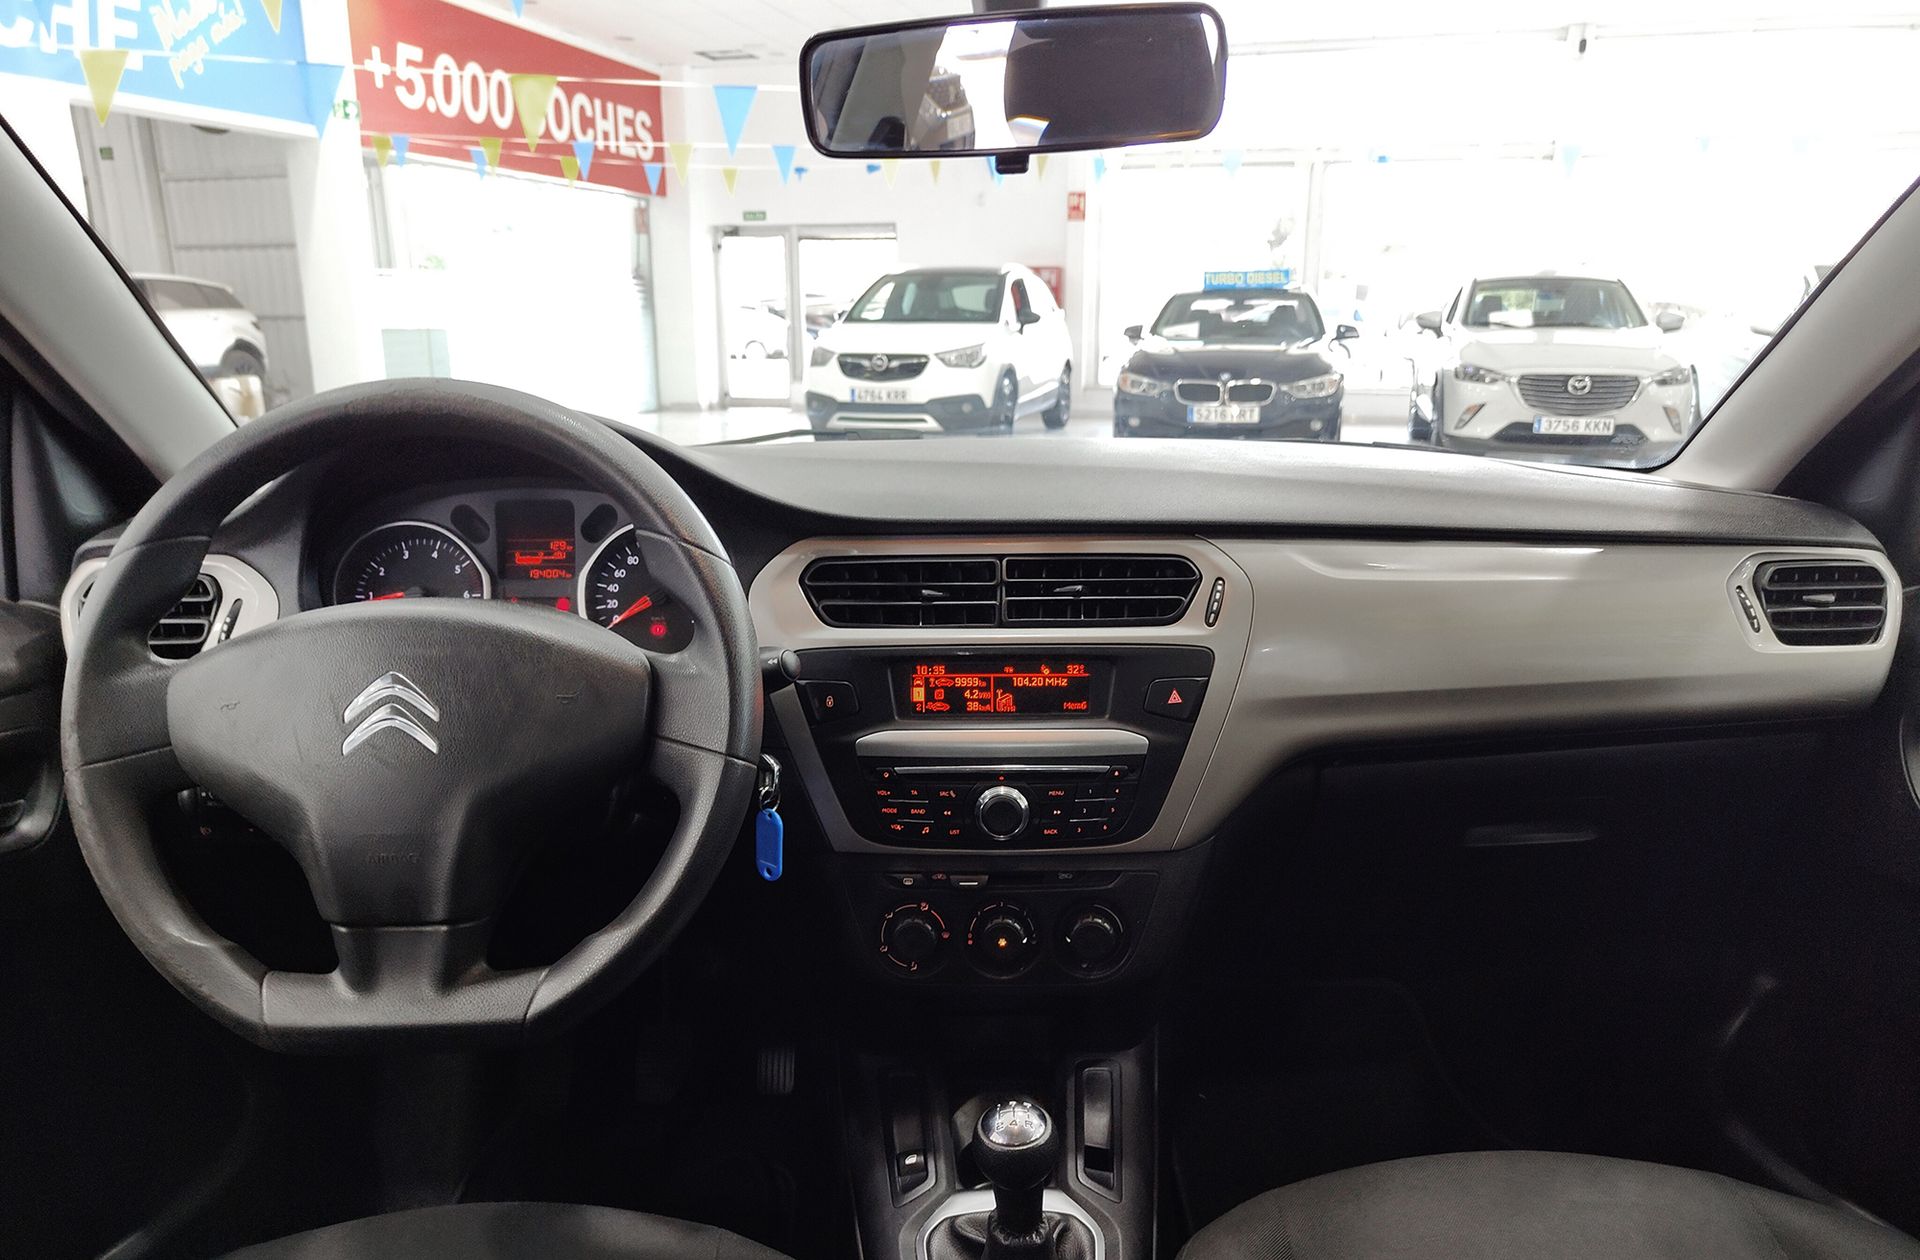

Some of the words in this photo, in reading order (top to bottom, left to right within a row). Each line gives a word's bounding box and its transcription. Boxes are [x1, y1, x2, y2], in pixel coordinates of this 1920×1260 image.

[364, 41, 514, 130] +5.000
[538, 86, 656, 161] OCHES
[1205, 272, 1244, 285] TURBO
[1247, 271, 1287, 285] DIESEL
[1196, 408, 1227, 421] 5216
[1230, 408, 1256, 421] RT
[1543, 420, 1580, 433] 3756
[1584, 420, 1612, 433] KKN
[403, 551, 409, 560] 3
[431, 550, 438, 559] 4
[626, 555, 639, 565] 80
[378, 567, 385, 576] 2
[454, 565, 461, 574] 5
[529, 569, 566, 579] 194004
[613, 568, 626, 578] 60
[606, 583, 619, 592] 40
[368, 591, 373, 600] 1
[463, 590, 470, 599] 6
[606, 599, 619, 608] 20
[915, 665, 946, 675] 10:35
[954, 677, 979, 687] 9999
[1012, 677, 1044, 687] 104.20
[1045, 677, 1069, 687] MHz
[964, 689, 979, 699] 4.2
[966, 701, 979, 711] 38
[1024, 1120, 1033, 1129] R
